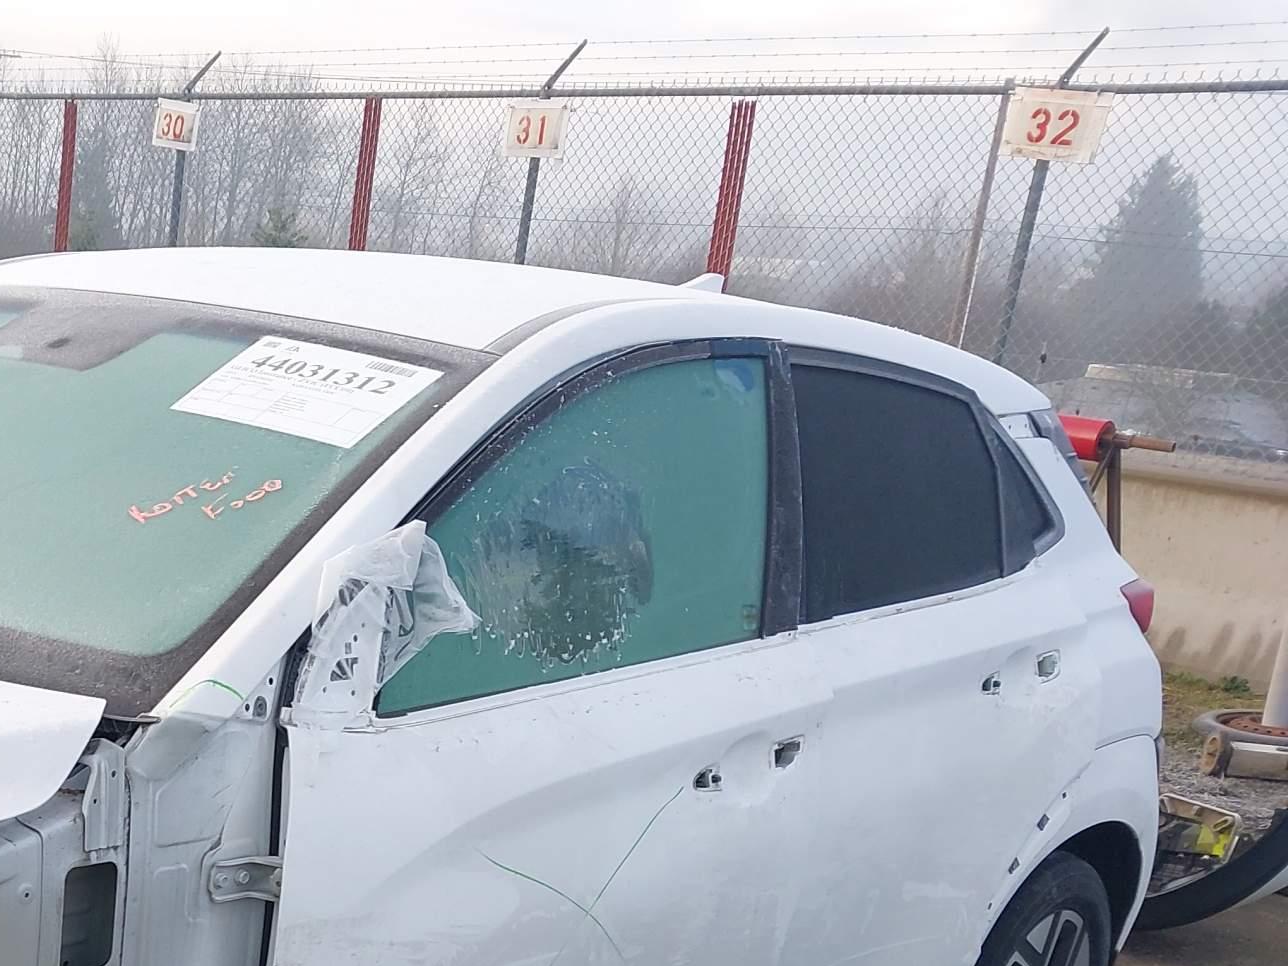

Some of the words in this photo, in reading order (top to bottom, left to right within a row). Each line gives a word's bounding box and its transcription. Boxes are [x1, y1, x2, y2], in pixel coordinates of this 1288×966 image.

[161, 112, 184, 139] 30
[515, 115, 548, 147] 31
[1025, 107, 1081, 147] 32
[251, 353, 396, 395] 44031312
